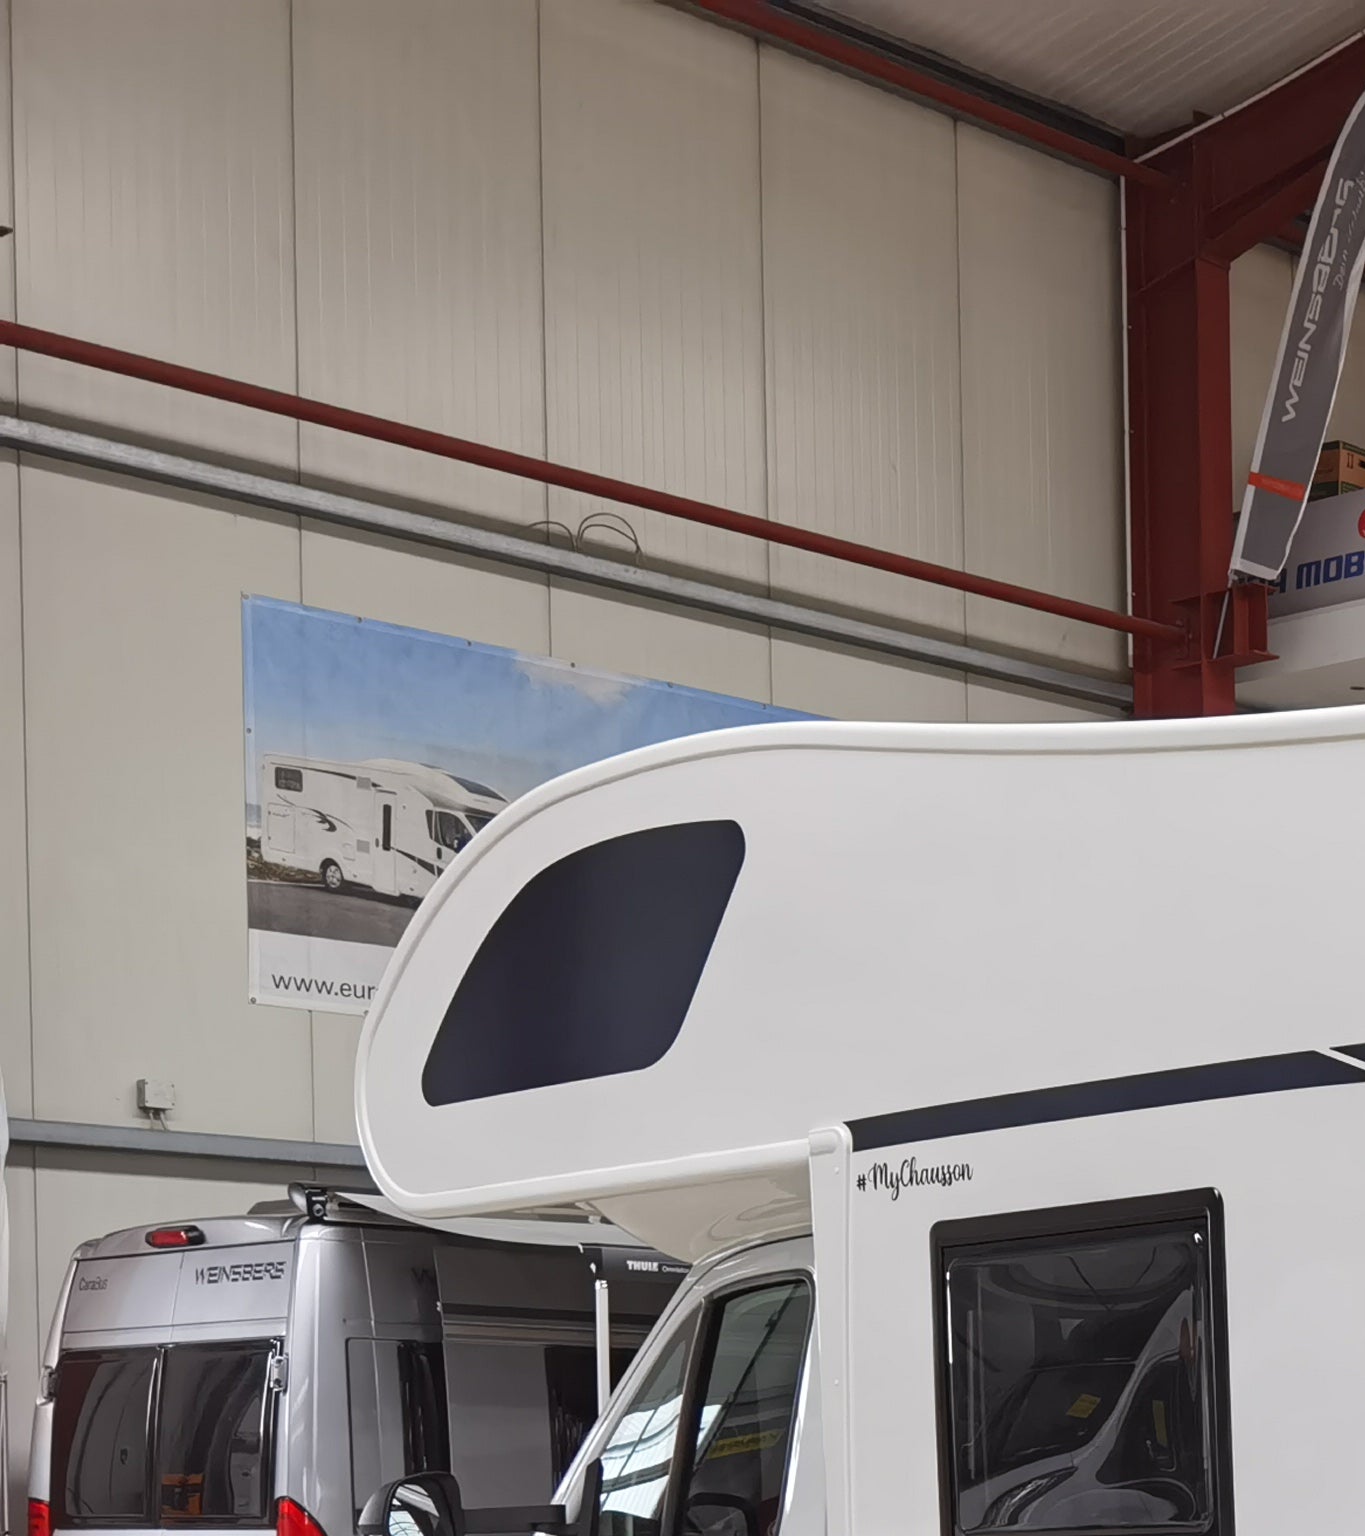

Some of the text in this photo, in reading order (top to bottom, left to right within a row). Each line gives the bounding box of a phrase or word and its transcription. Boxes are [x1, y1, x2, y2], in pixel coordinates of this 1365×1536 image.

[1281, 178, 1356, 423] WEINSBERG
[271, 973, 379, 1001] www.eur
[856, 1156, 974, 1201] #MyChausson
[195, 1261, 287, 1285] WEINSBERG
[626, 1260, 659, 1273] THULE
